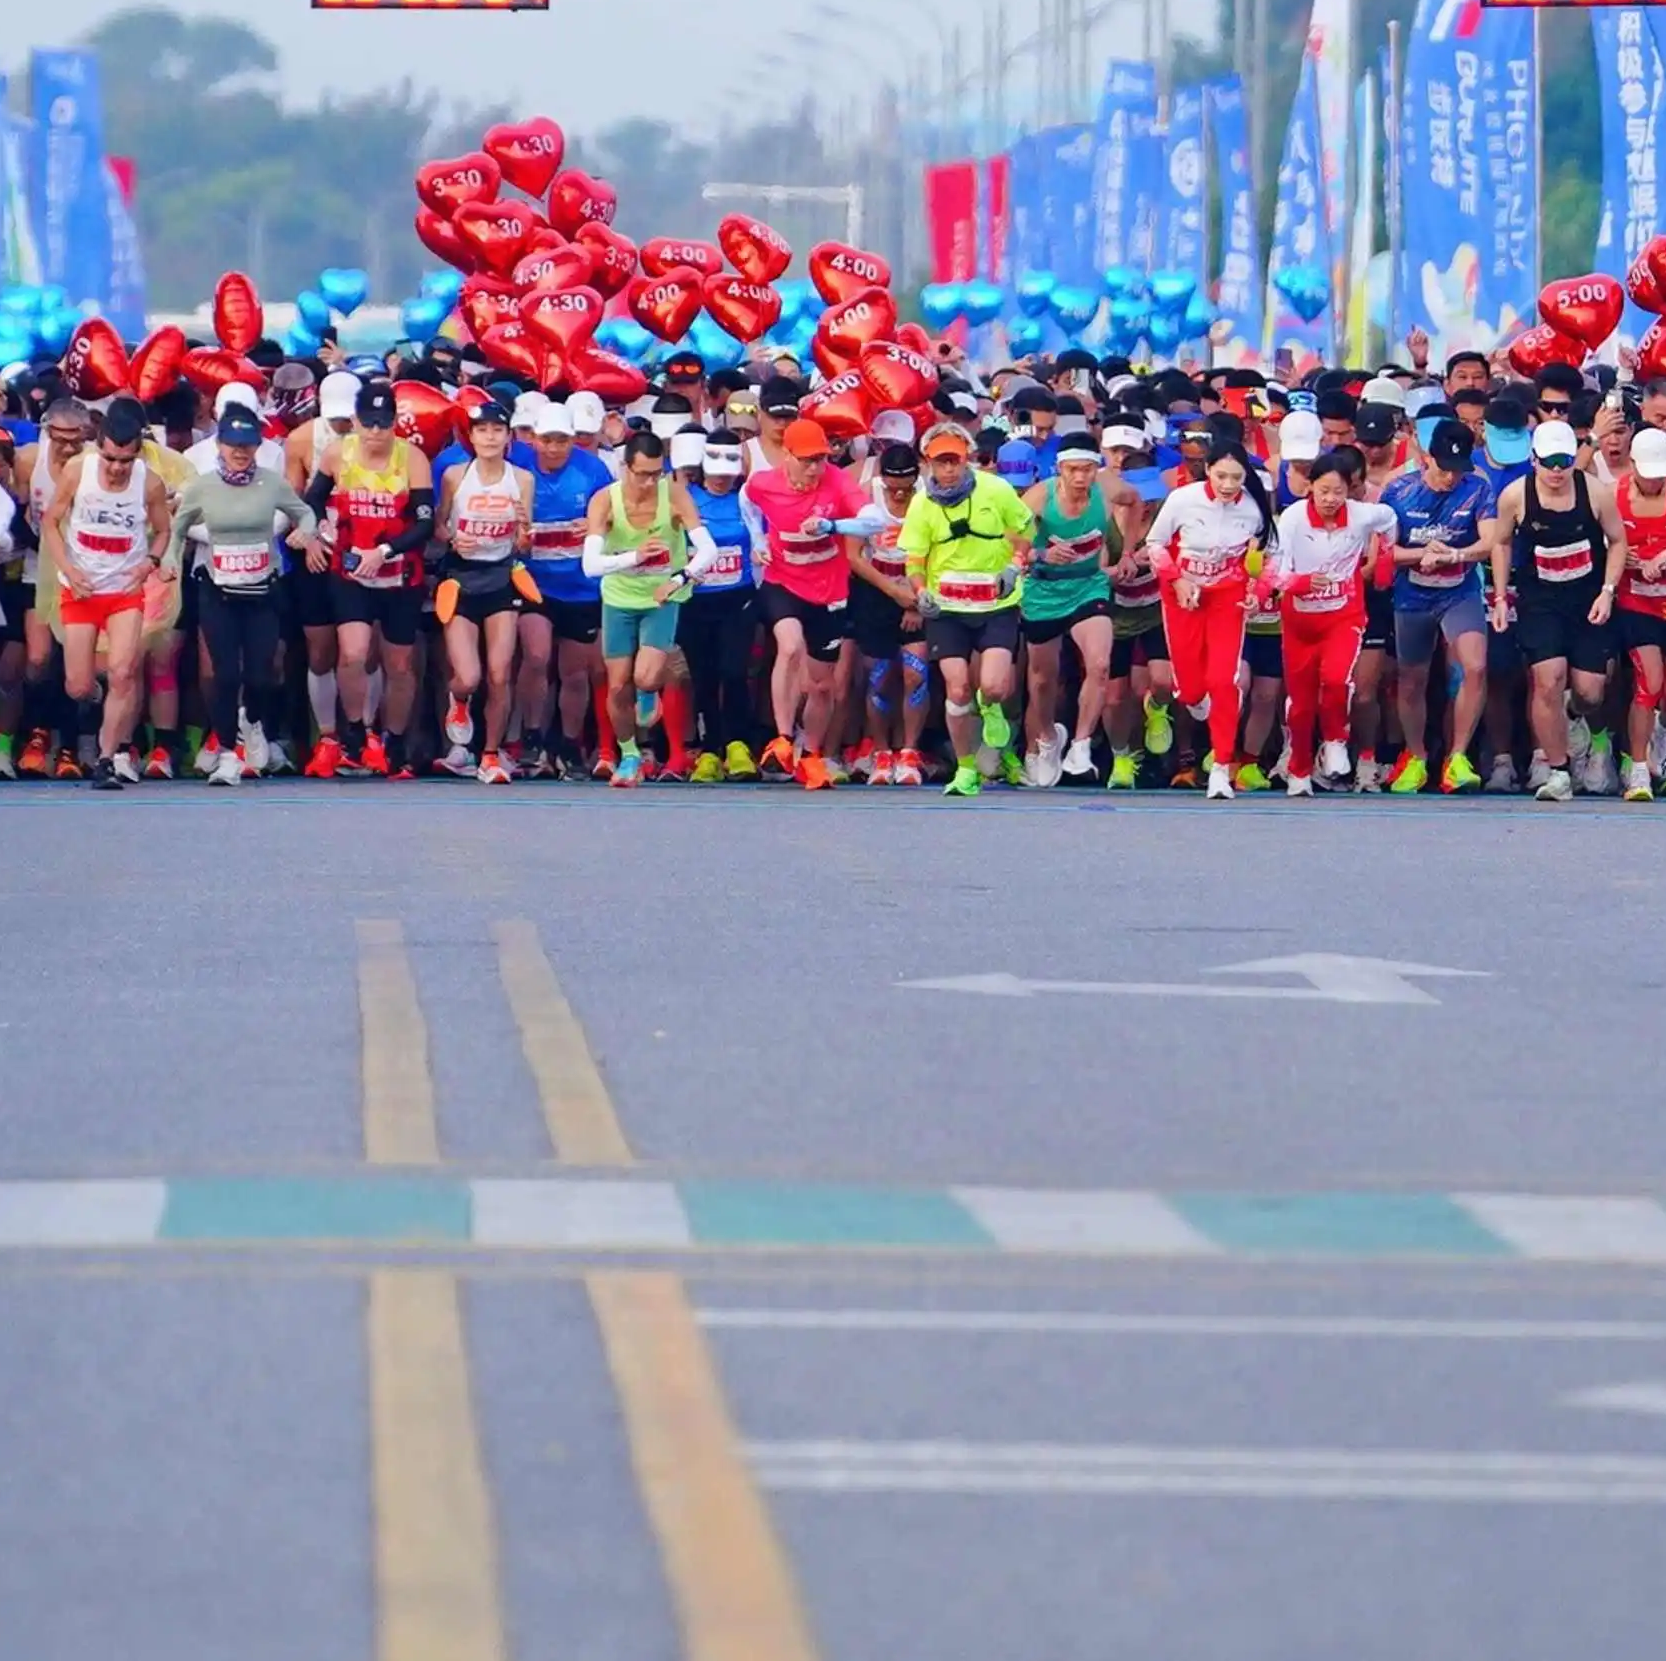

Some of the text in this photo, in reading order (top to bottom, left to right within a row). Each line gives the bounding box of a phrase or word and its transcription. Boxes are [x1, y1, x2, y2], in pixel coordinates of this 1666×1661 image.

[432, 169, 481, 196] 3:30
[749, 224, 790, 253] 4:00
[604, 246, 636, 271] 3:3
[659, 245, 707, 263] 4:00
[830, 253, 878, 280] 4:00
[538, 293, 587, 312] 4:30
[637, 284, 680, 310] 4:00
[727, 280, 773, 303] 4:00
[1556, 283, 1607, 309] 5:00
[828, 302, 871, 336] 4:00
[886, 346, 933, 378] 3:00
[813, 374, 861, 407] 3:00
